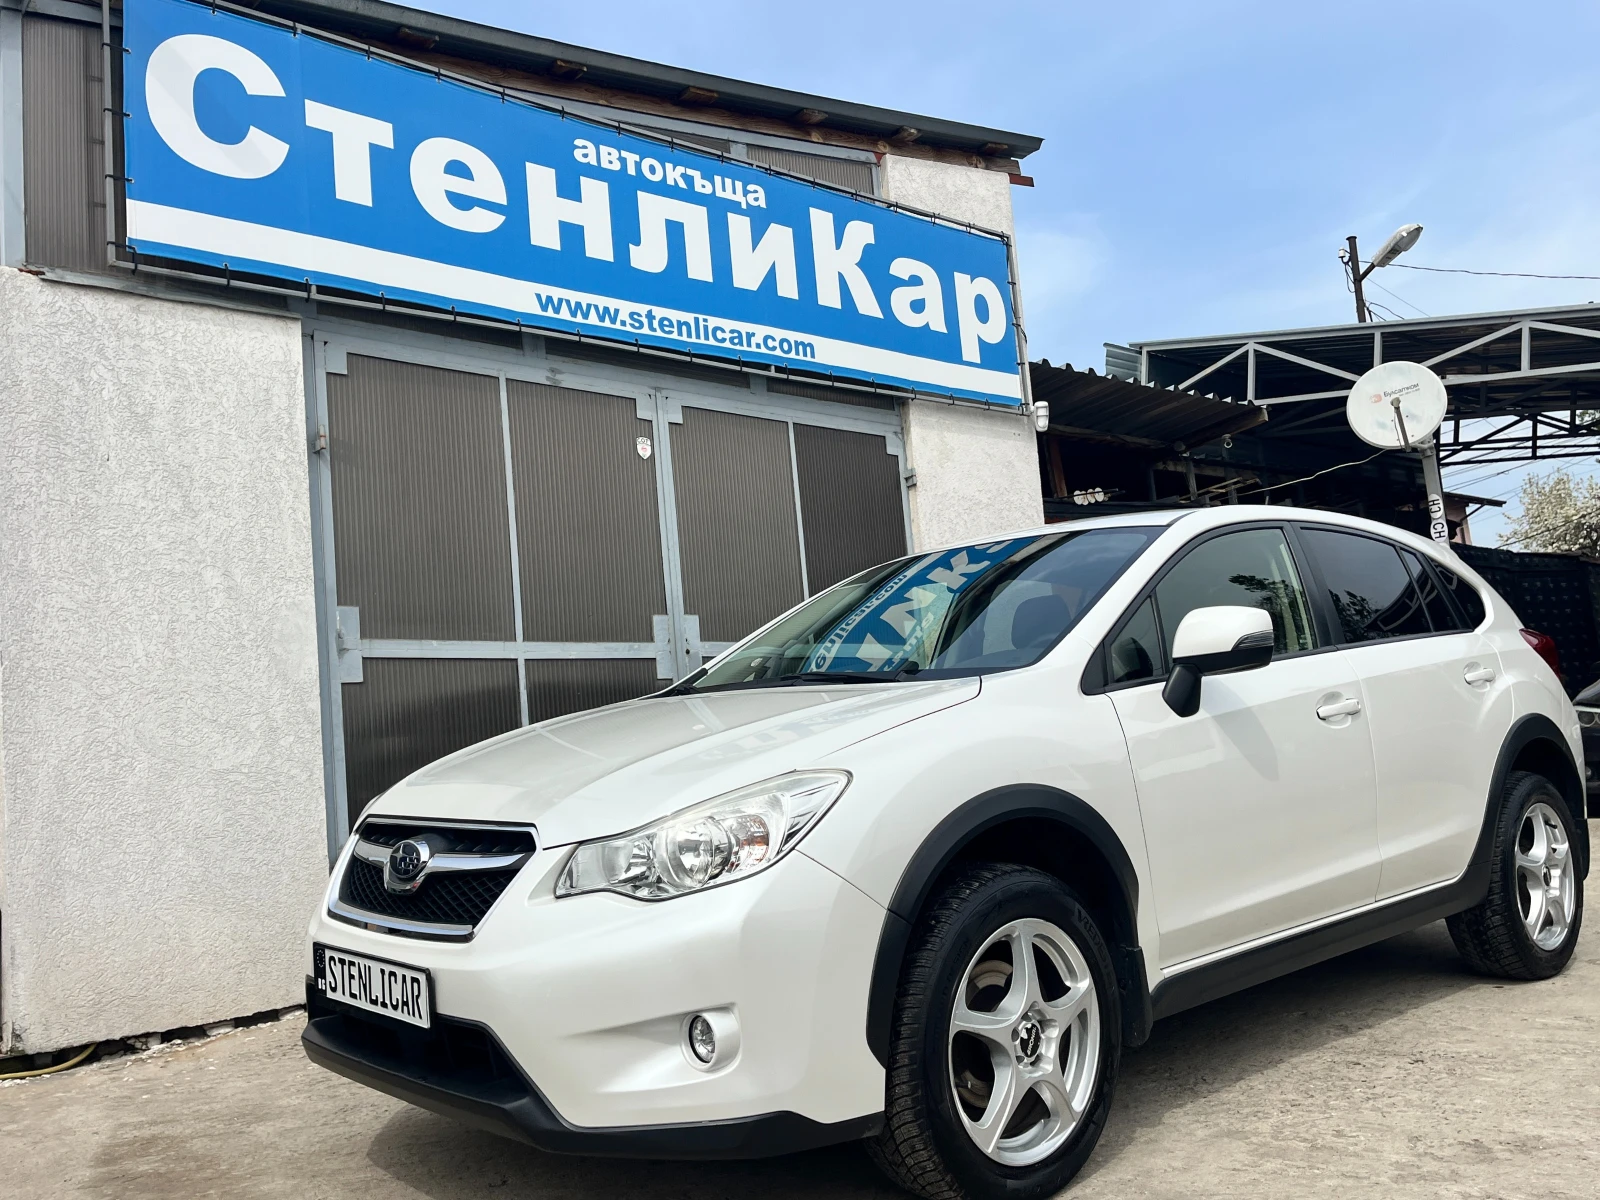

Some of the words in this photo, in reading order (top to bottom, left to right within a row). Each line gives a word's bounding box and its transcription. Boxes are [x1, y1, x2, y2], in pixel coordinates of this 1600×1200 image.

[145, 34, 1007, 363] СтенлиКар
[573, 138, 767, 209] автокъща
[535, 293, 816, 360] www.stenlicar.com
[1433, 522, 1446, 539] CH
[328, 955, 423, 1020] STENLICAR
